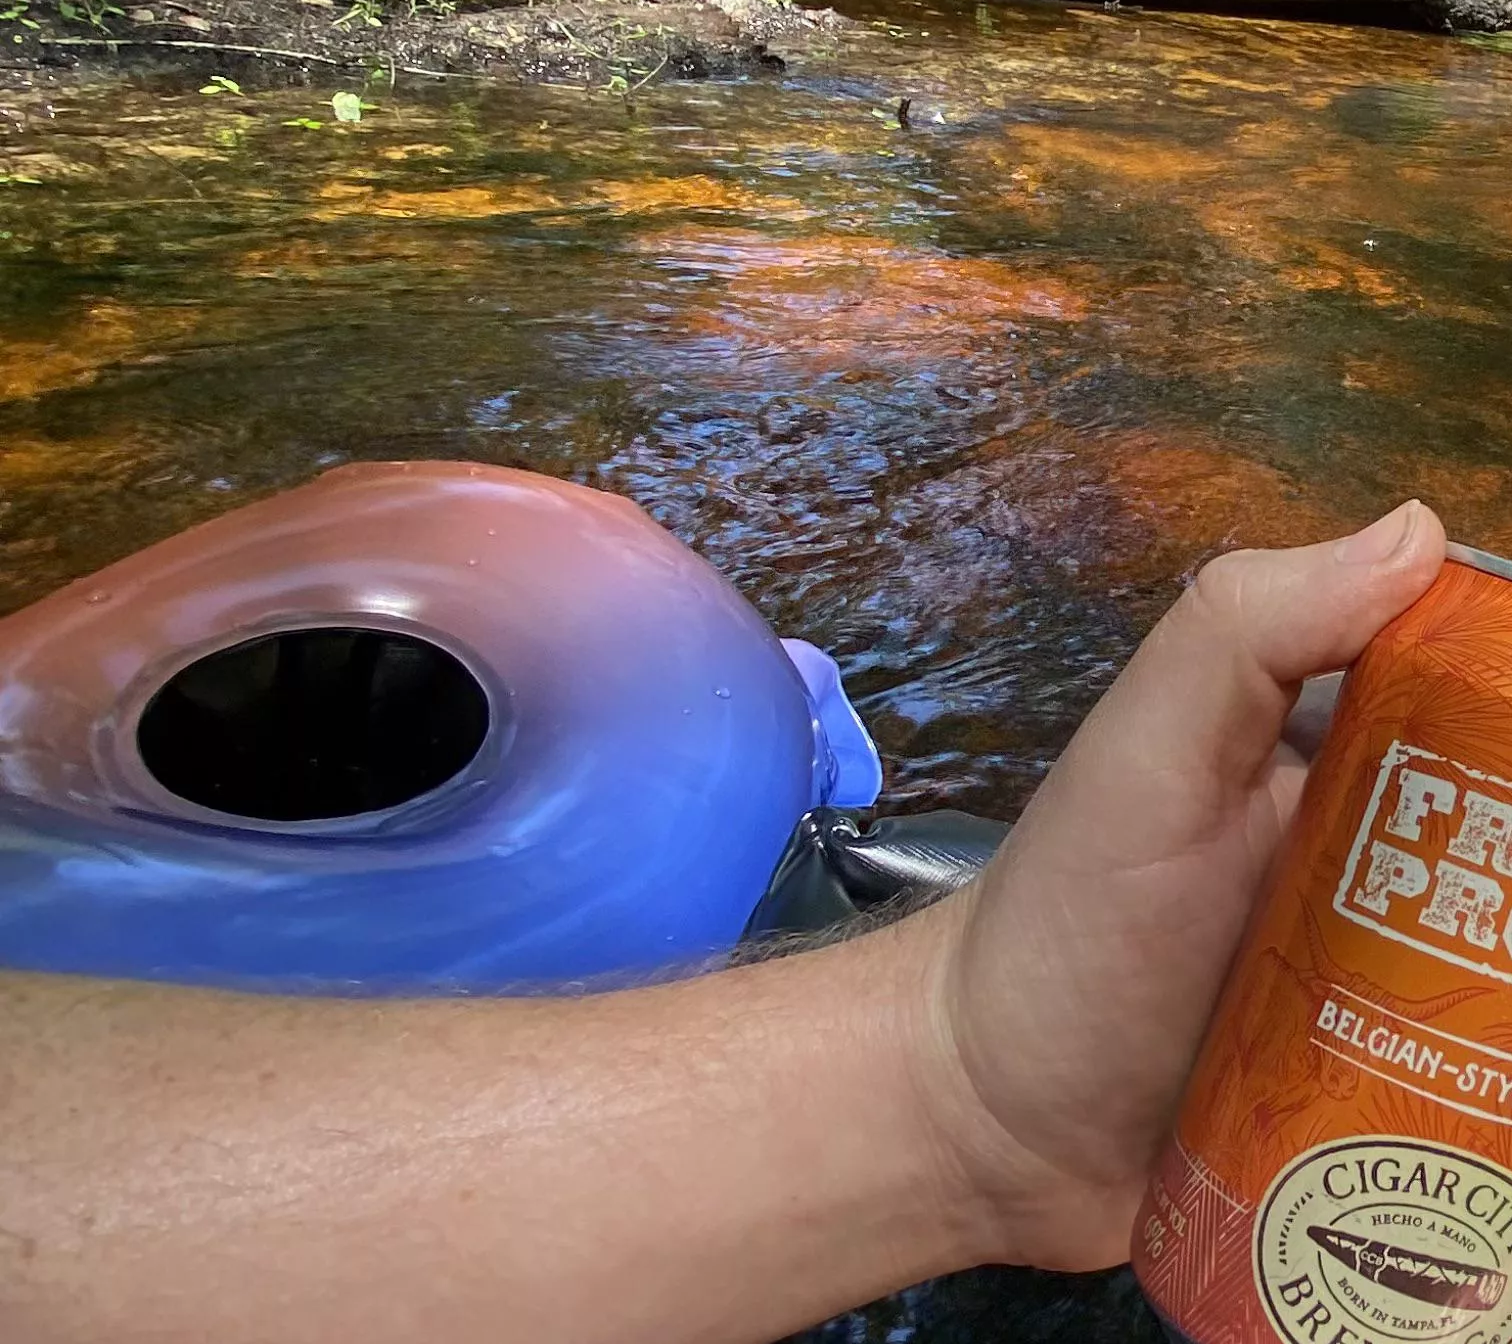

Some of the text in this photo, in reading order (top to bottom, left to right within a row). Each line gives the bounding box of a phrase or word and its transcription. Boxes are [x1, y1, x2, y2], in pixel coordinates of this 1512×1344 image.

[1322, 1157, 1461, 1205] CIGAR
[1371, 1213, 1477, 1253] HECHO A MANO
[1336, 1277, 1370, 1312] BORN
[1371, 1307, 1389, 1323] IN
